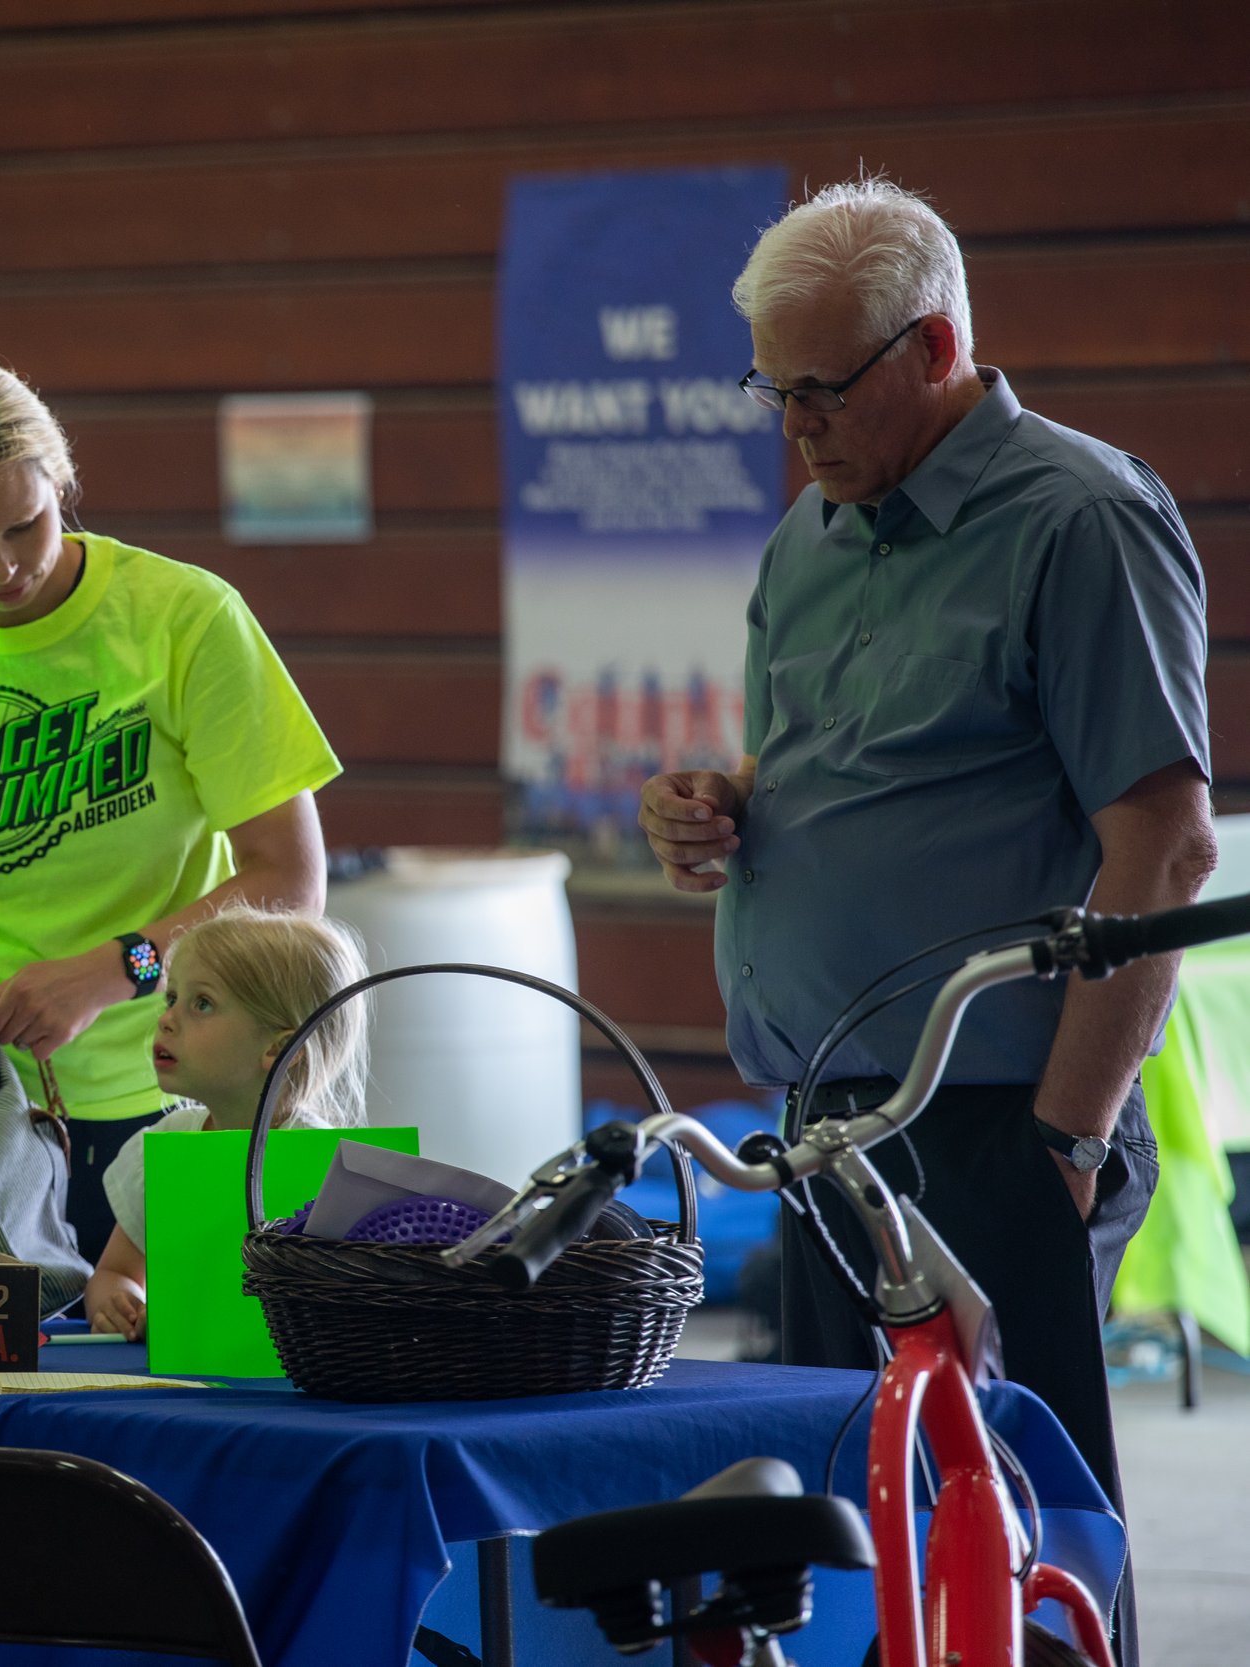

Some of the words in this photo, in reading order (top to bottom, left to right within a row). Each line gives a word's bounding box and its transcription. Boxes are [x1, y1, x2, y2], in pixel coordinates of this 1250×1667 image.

[599, 305, 678, 362] WE
[515, 381, 651, 437] WANT
[73, 781, 157, 833] ABERDEEN
